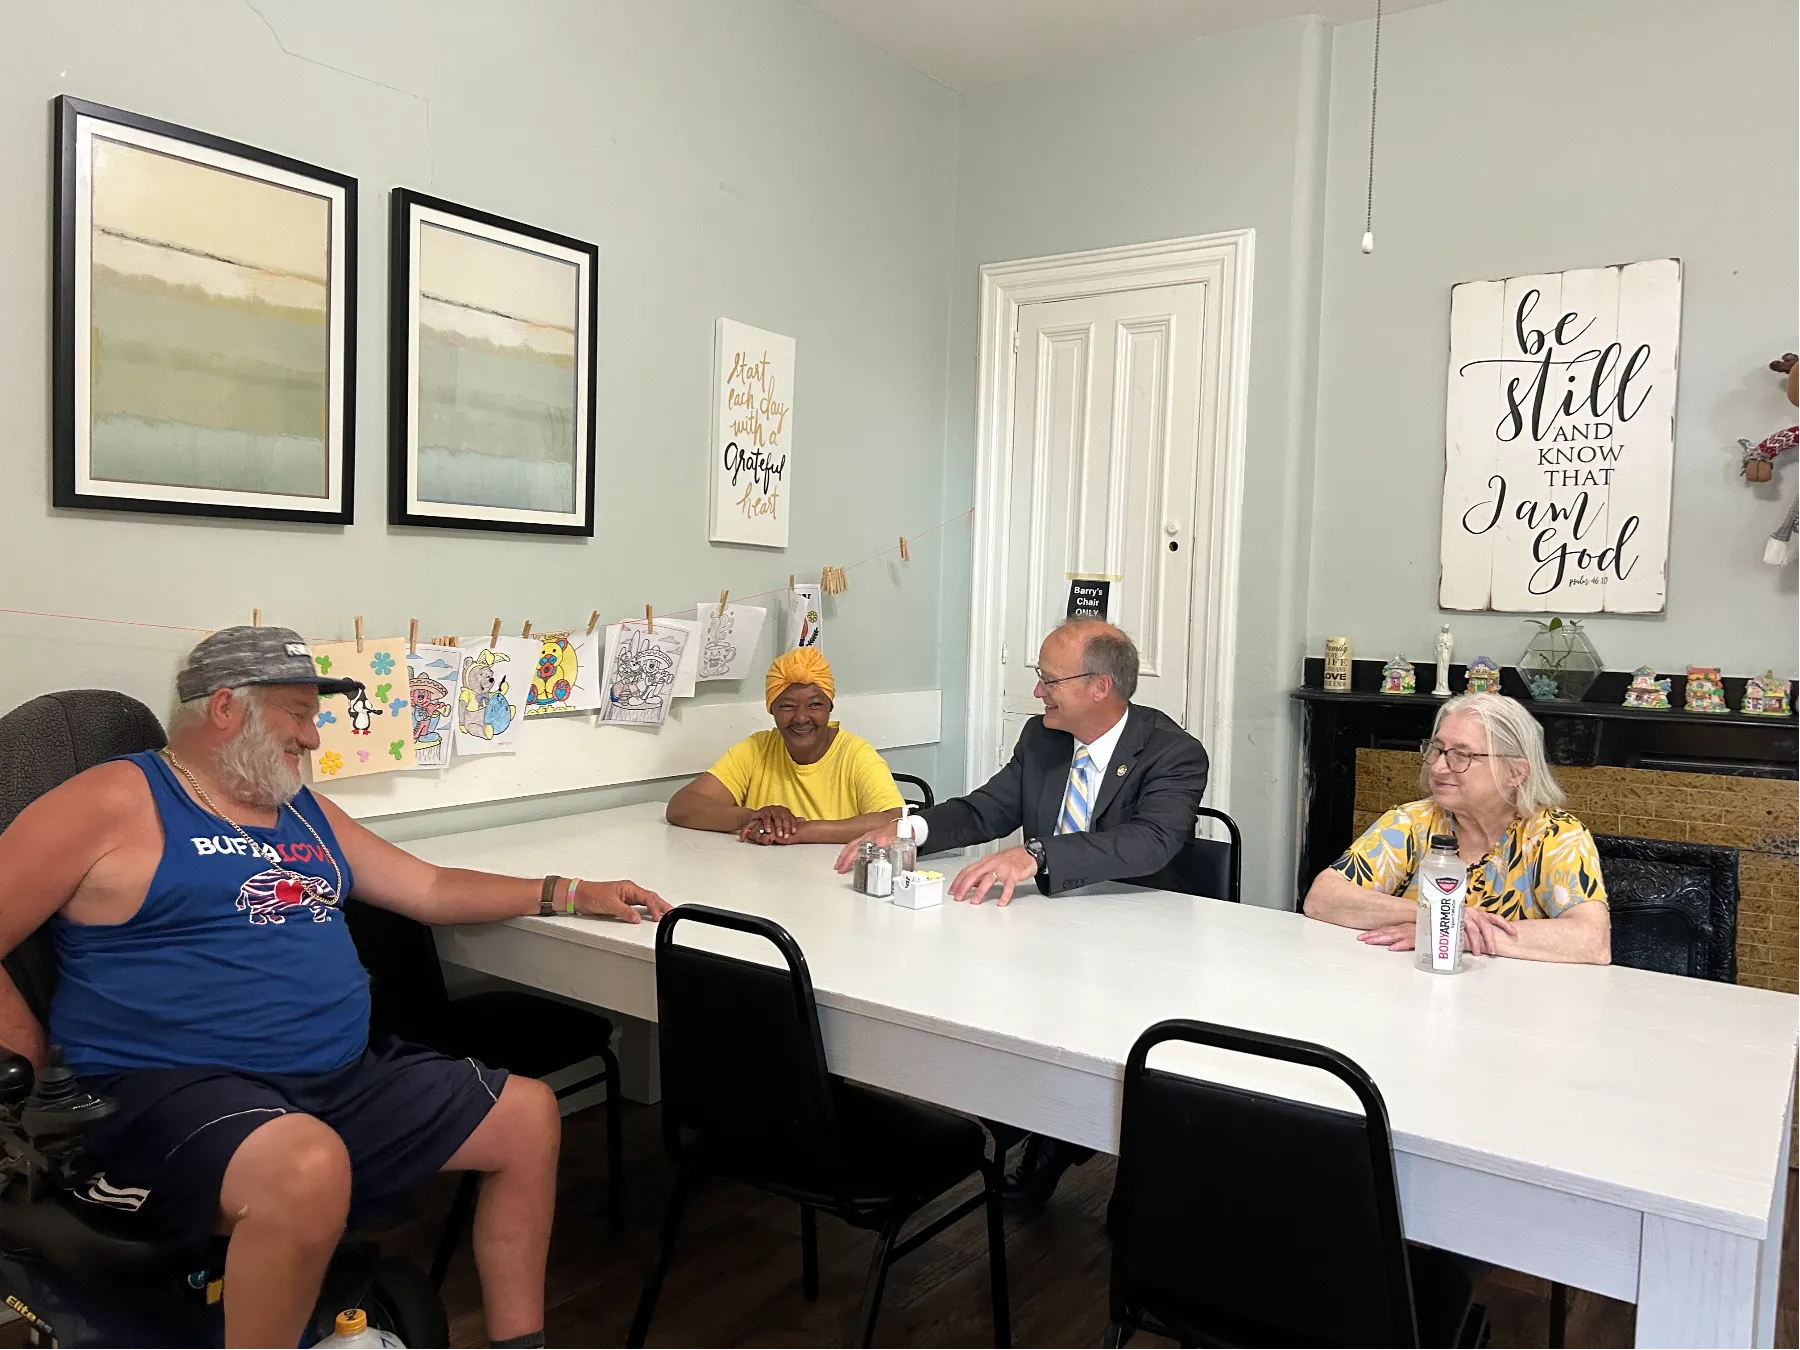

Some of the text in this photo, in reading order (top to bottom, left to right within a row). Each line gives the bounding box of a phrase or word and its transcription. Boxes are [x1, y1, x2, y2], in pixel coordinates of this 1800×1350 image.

[1516, 289, 1597, 355] be
[728, 375, 789, 433] each day
[1460, 342, 1653, 442] still
[730, 409, 778, 447] with a
[1552, 423, 1613, 443] AND
[1537, 445, 1624, 466] KNOW
[1544, 468, 1615, 487] THAT
[736, 482, 779, 519] heart
[1462, 475, 1605, 540] I am
[1528, 516, 1639, 595] God
[1074, 587, 1102, 596] Barry's
[1076, 598, 1100, 606] Chair
[1076, 608, 1099, 616] ONLY
[1438, 898, 1451, 960] BODYARMOR
[5, 1295, 36, 1321] Elite
